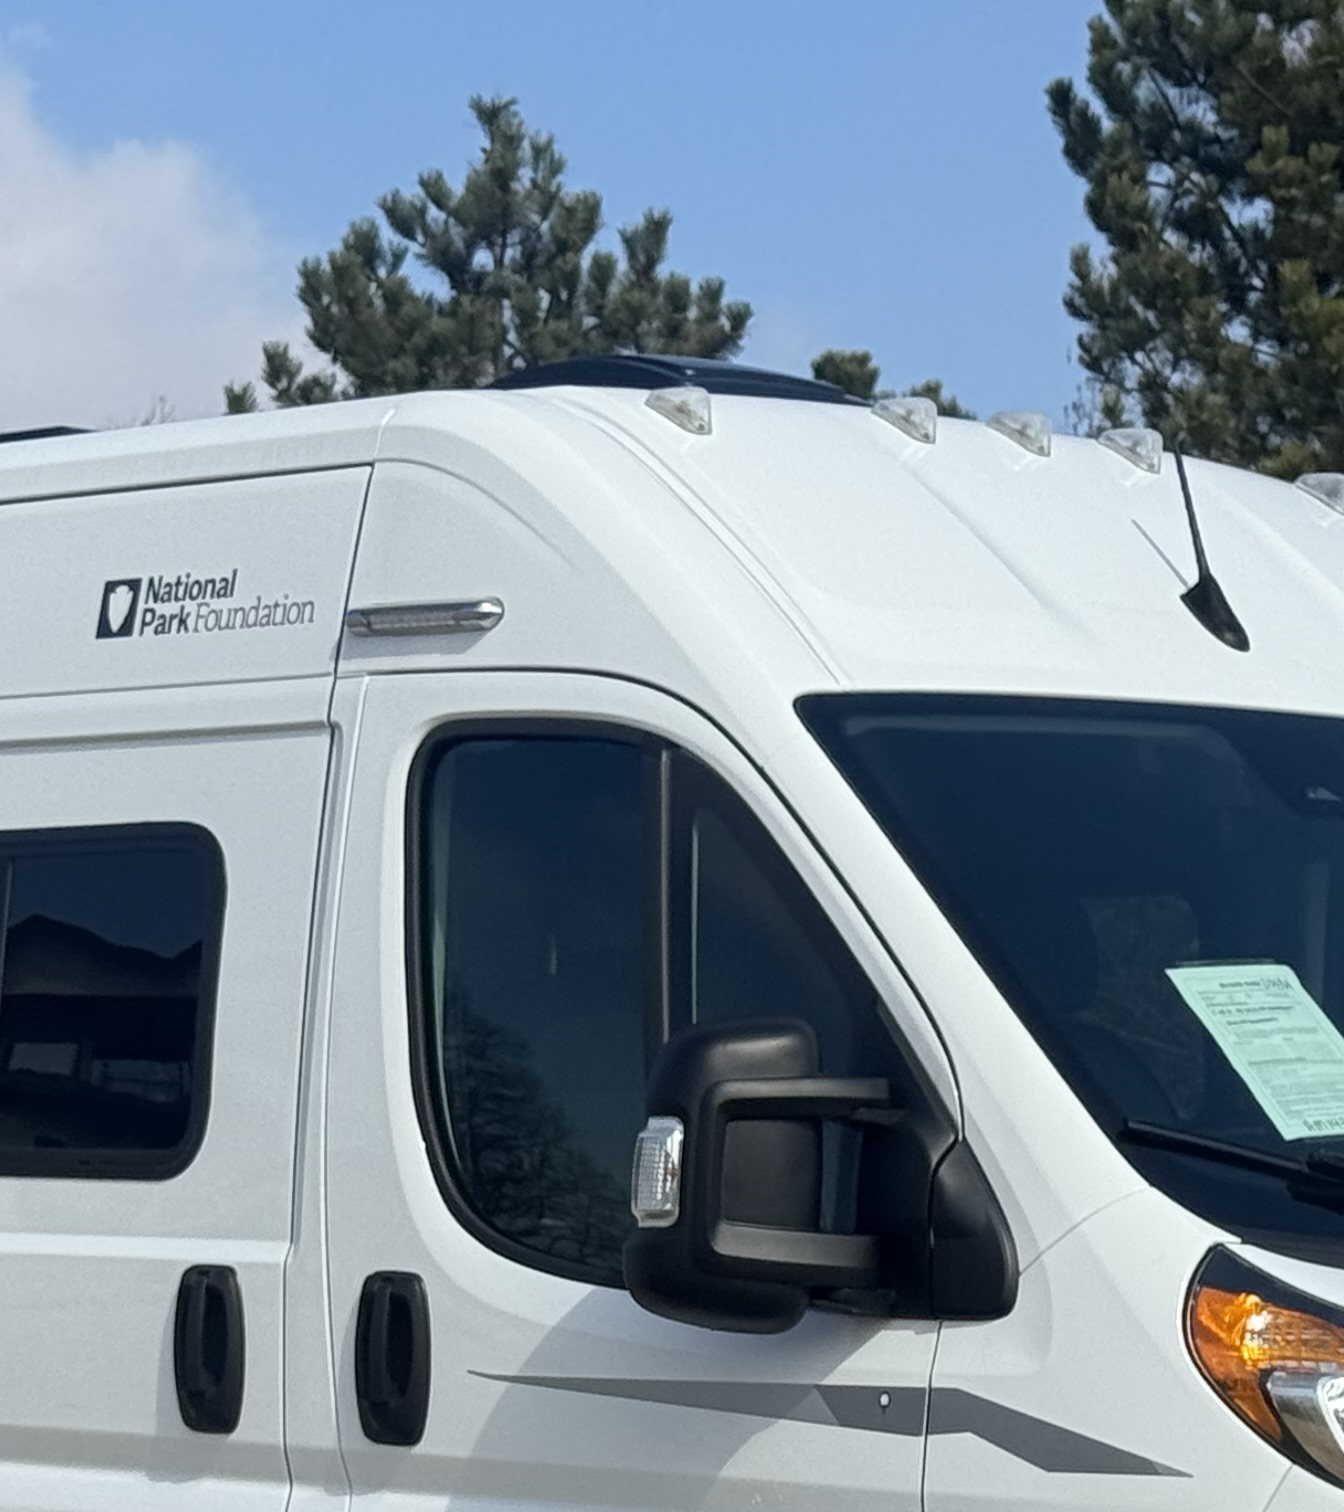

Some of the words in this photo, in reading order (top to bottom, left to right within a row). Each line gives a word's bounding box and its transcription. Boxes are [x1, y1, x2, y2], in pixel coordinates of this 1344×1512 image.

[144, 568, 238, 601] National
[139, 605, 190, 636] Park
[192, 594, 316, 634] Foundation
